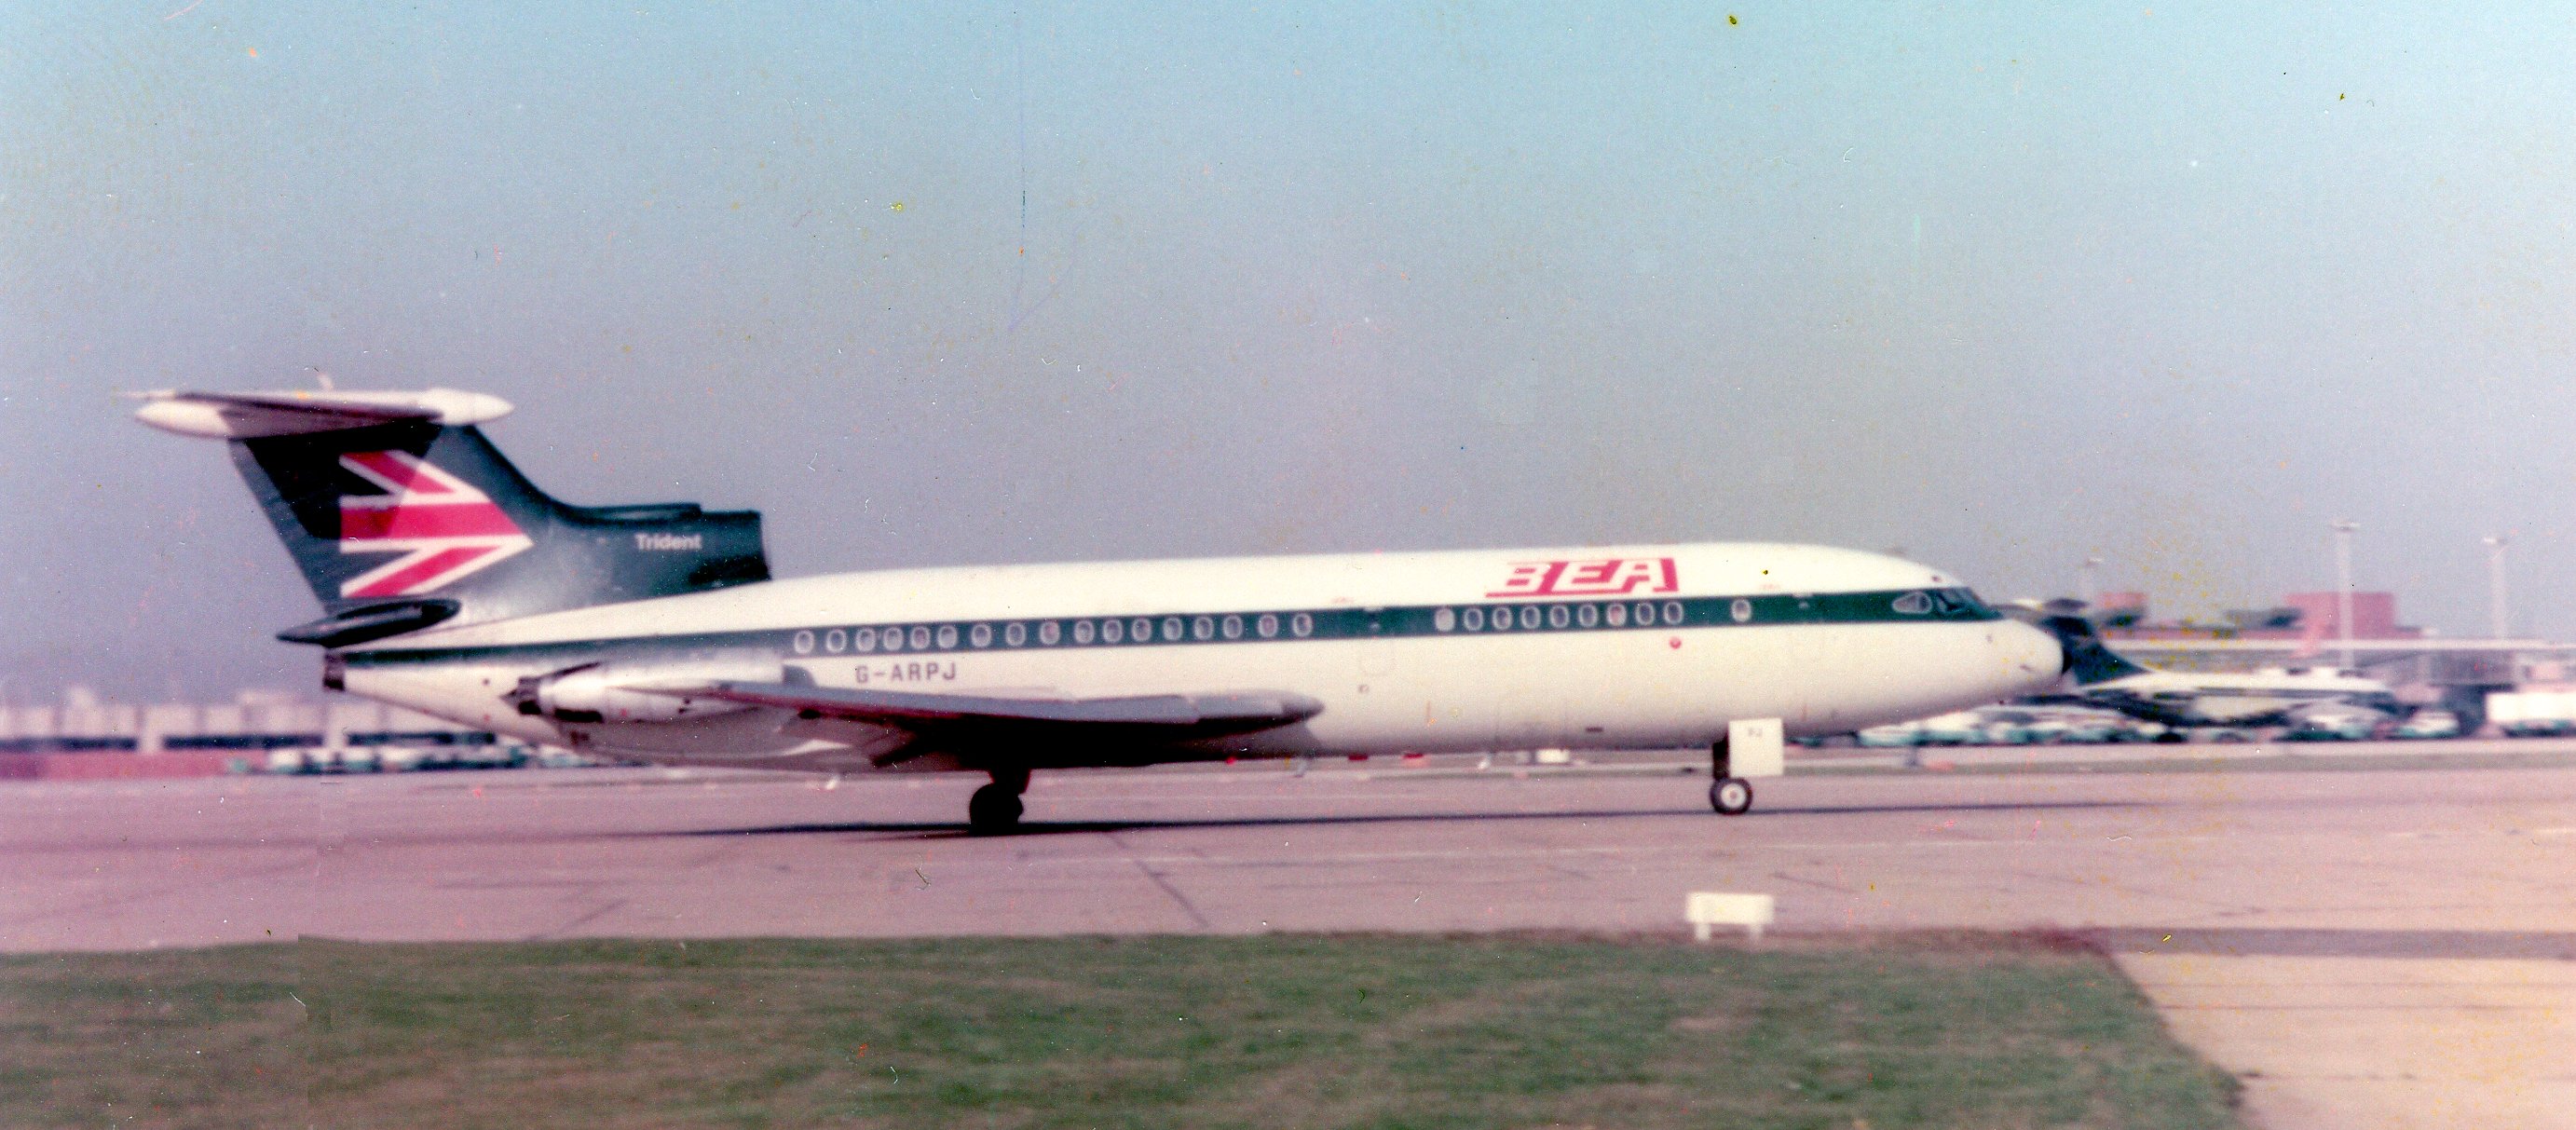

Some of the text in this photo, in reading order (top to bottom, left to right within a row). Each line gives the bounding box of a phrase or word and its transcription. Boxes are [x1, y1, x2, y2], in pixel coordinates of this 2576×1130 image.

[635, 533, 702, 551] Trident
[1486, 557, 1678, 598] BEA
[855, 661, 956, 683] G-ARPJ
